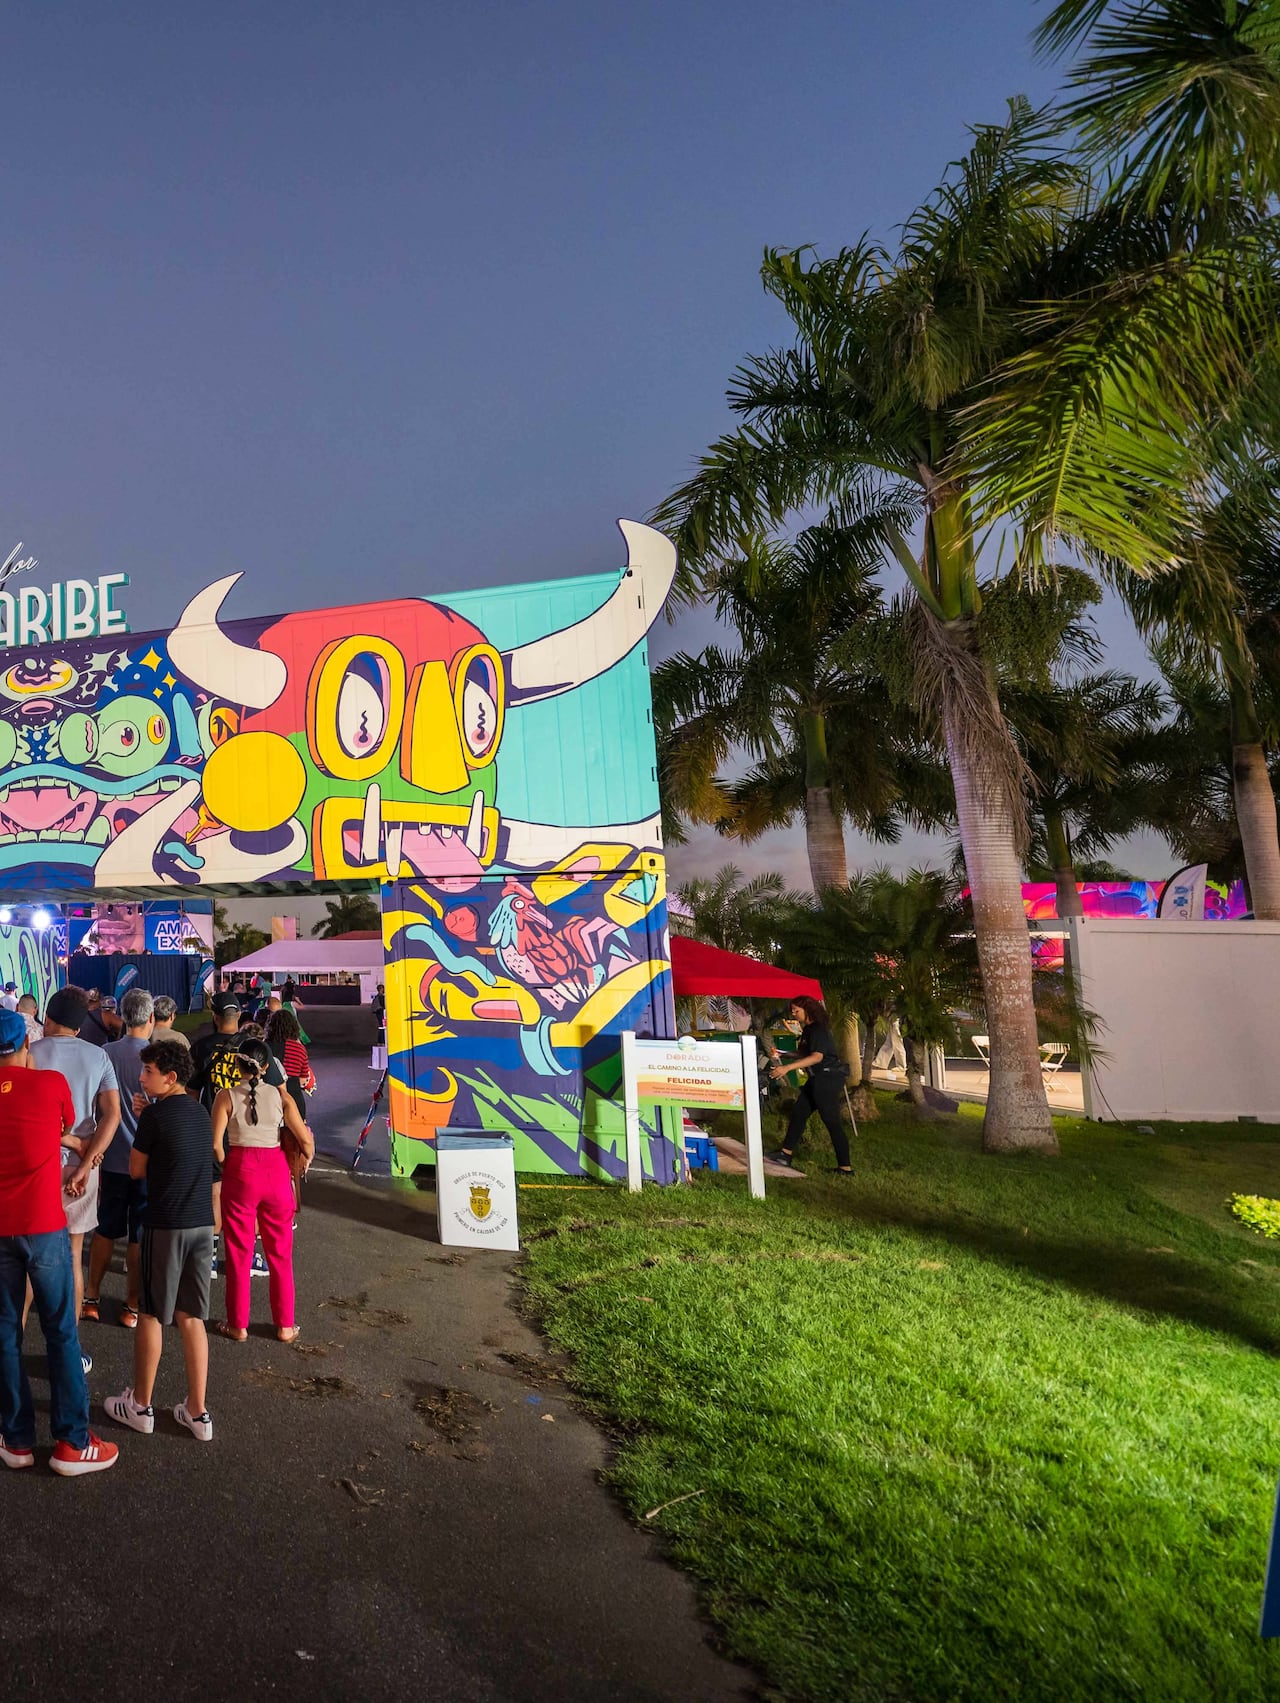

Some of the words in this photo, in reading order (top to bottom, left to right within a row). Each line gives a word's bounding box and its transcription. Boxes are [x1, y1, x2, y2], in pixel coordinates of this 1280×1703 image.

[157, 935, 181, 951] EX
[666, 1053, 710, 1062] DORADO
[667, 1077, 712, 1085] FELICIDAD
